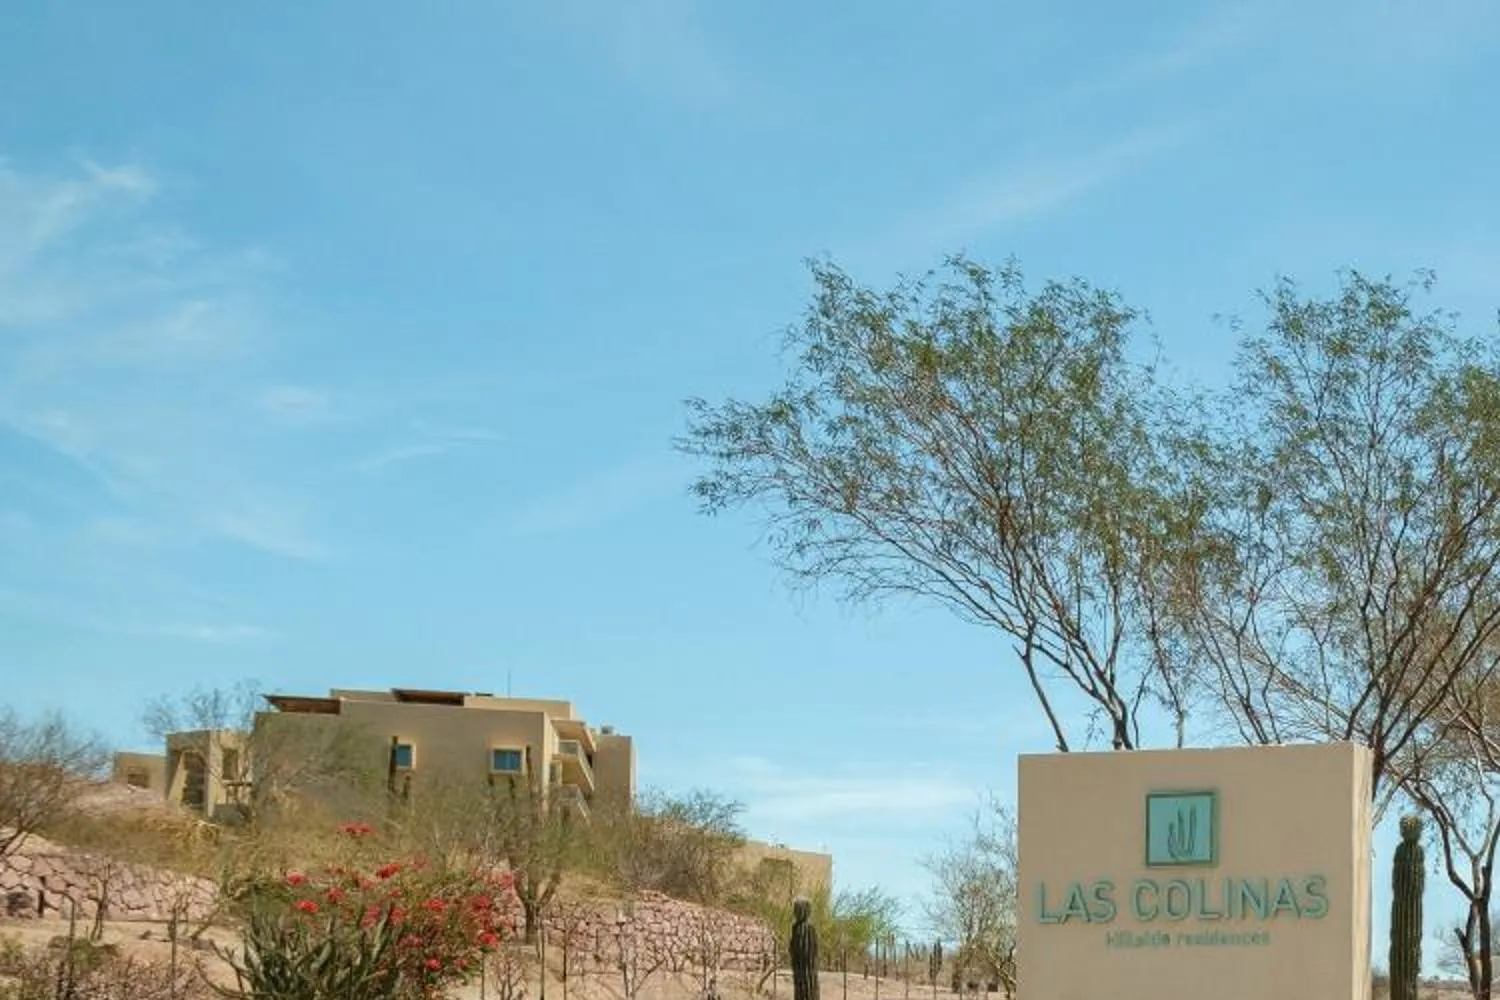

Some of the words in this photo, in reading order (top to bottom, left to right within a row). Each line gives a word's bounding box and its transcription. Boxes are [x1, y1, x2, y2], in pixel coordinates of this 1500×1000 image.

[1036, 880, 1118, 925] LAS
[1131, 874, 1330, 921] COLINAS
[1177, 930, 1271, 946] residences
